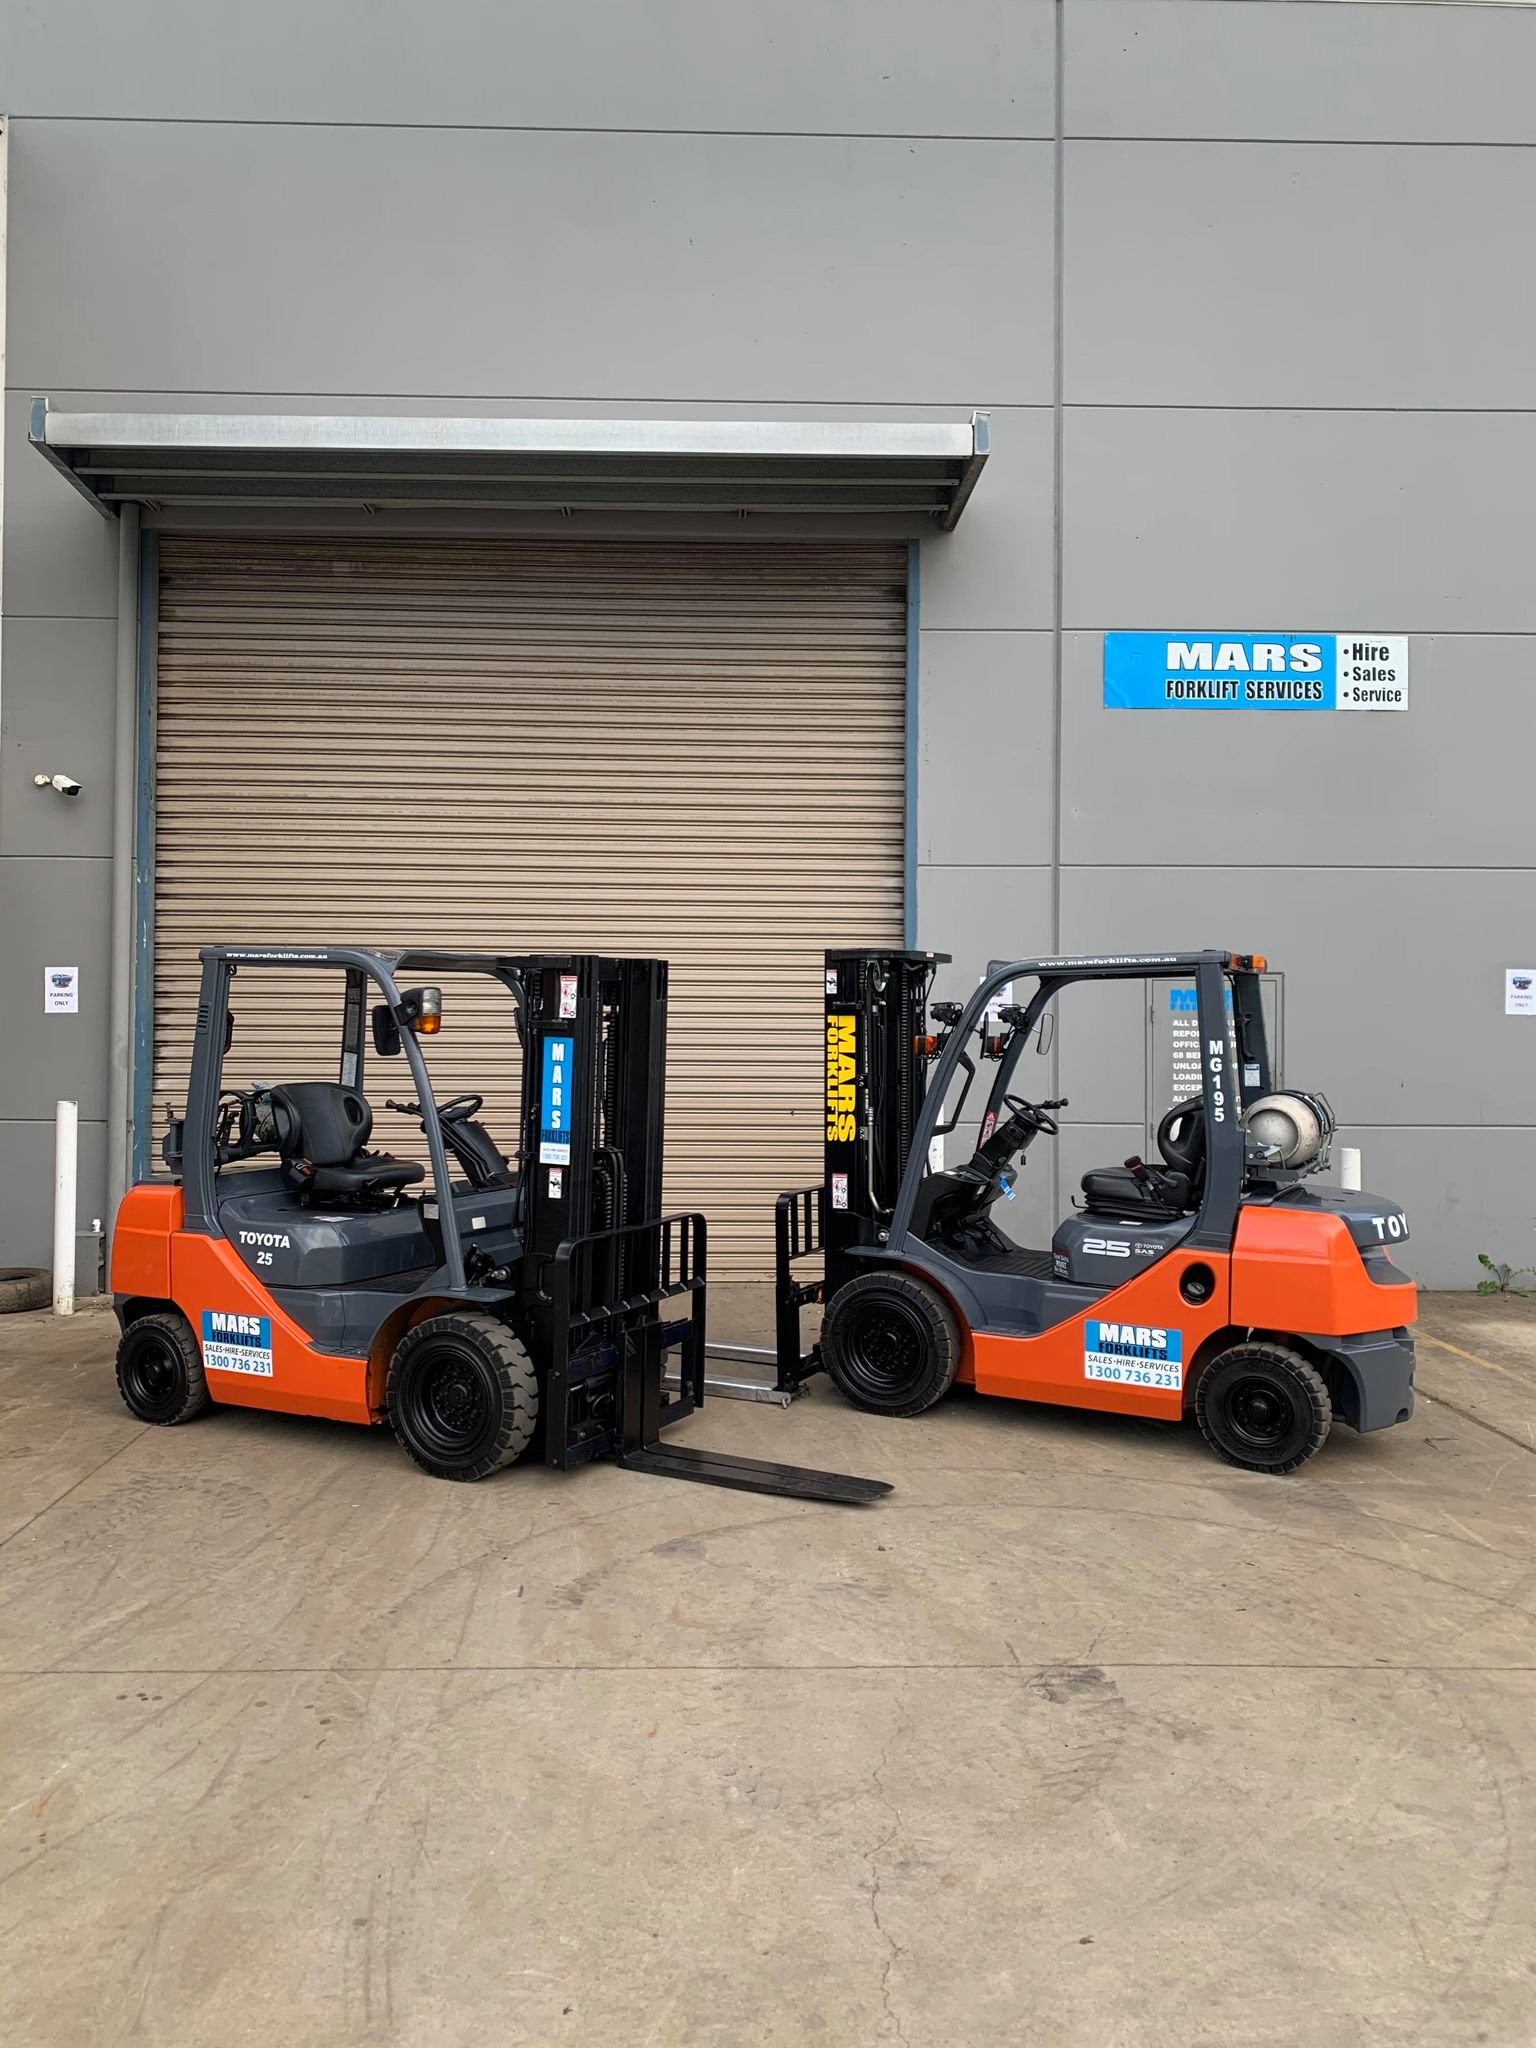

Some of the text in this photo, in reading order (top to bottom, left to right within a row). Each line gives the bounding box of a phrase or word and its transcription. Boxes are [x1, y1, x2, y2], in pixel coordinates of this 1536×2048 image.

[1166, 642, 1322, 672] MARS
[1352, 643, 1389, 662] Hire
[1352, 666, 1396, 682] Sales
[1166, 680, 1322, 700] FORKLIFT SERVICES
[1352, 688, 1402, 703] Service
[1038, 957, 1177, 967] www.marsforklifts.com.au
[551, 1043, 565, 1129] MARS
[827, 1015, 839, 1142] FORKLIFTS
[838, 1015, 856, 1142] MARS
[1209, 1040, 1225, 1122] MG195
[239, 1231, 290, 1249] TOYOTA
[1082, 1238, 1131, 1258] 25
[256, 1251, 273, 1266] 25
[211, 1312, 260, 1336] MARS
[212, 1331, 261, 1348] FORKLIFTS
[1099, 1322, 1167, 1349] MARS
[1098, 1342, 1168, 1360] FORKLIFTS
[205, 1354, 271, 1374] 1300 736 231
[1088, 1365, 1180, 1387] 1300 736 231
